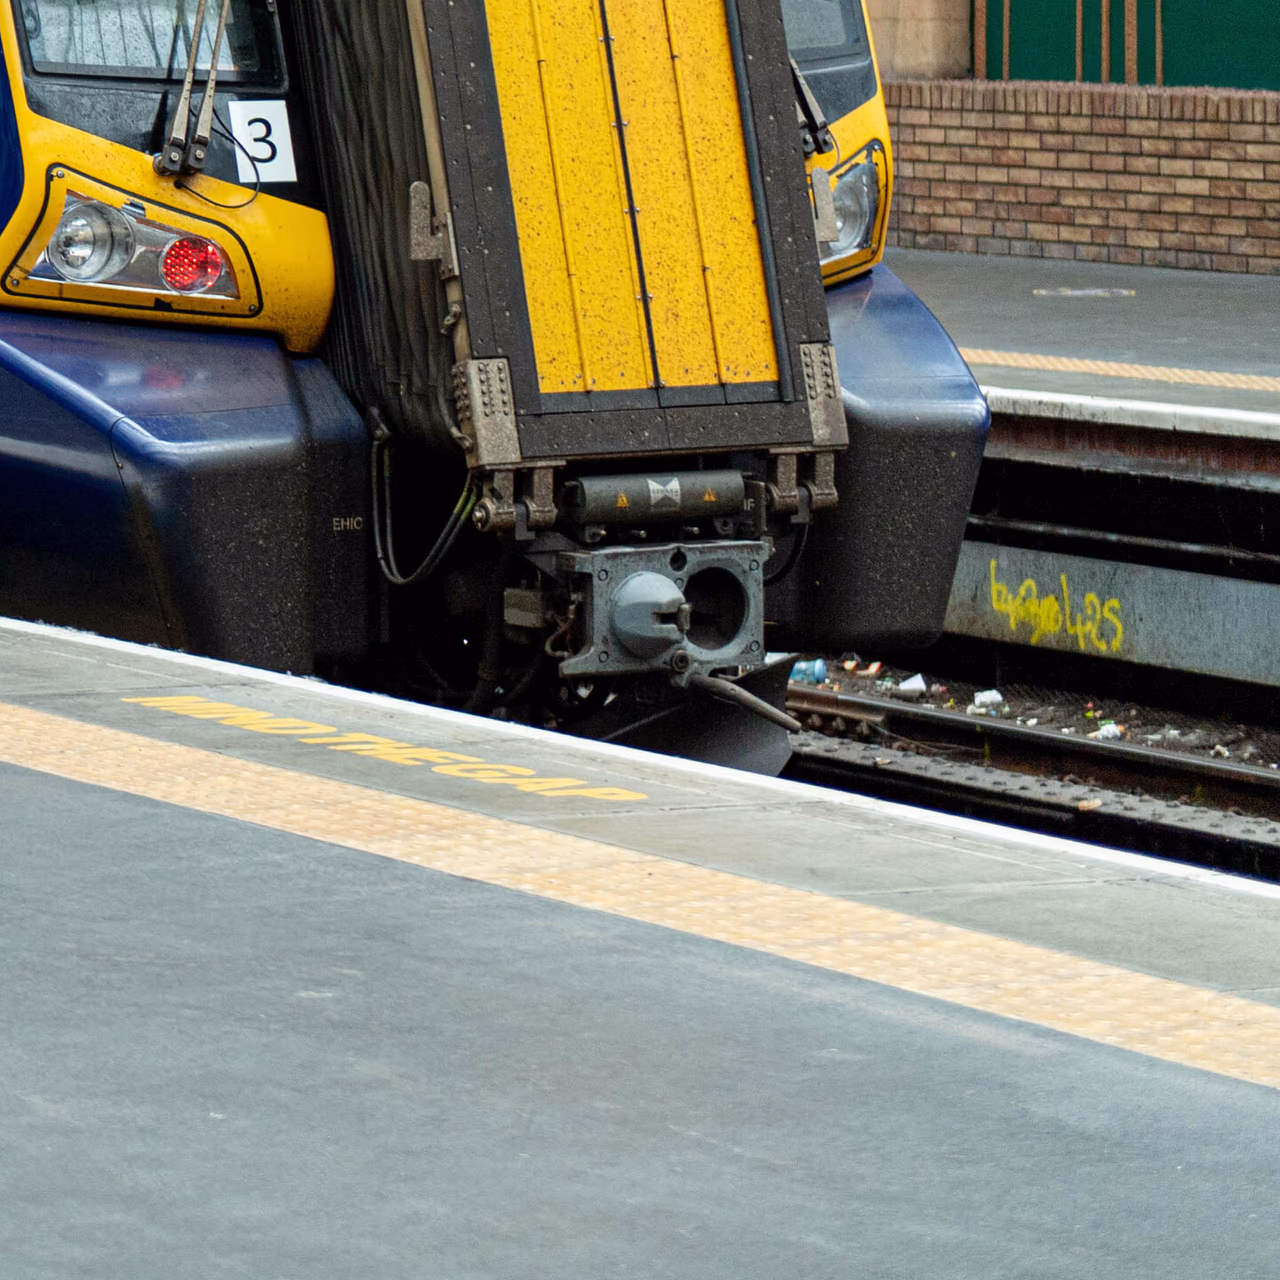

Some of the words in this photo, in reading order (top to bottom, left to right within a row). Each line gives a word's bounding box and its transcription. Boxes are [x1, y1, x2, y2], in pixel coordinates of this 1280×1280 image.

[247, 117, 277, 163] 3
[120, 695, 338, 736] MIND
[297, 731, 484, 766] THE
[431, 763, 649, 801] GAP
